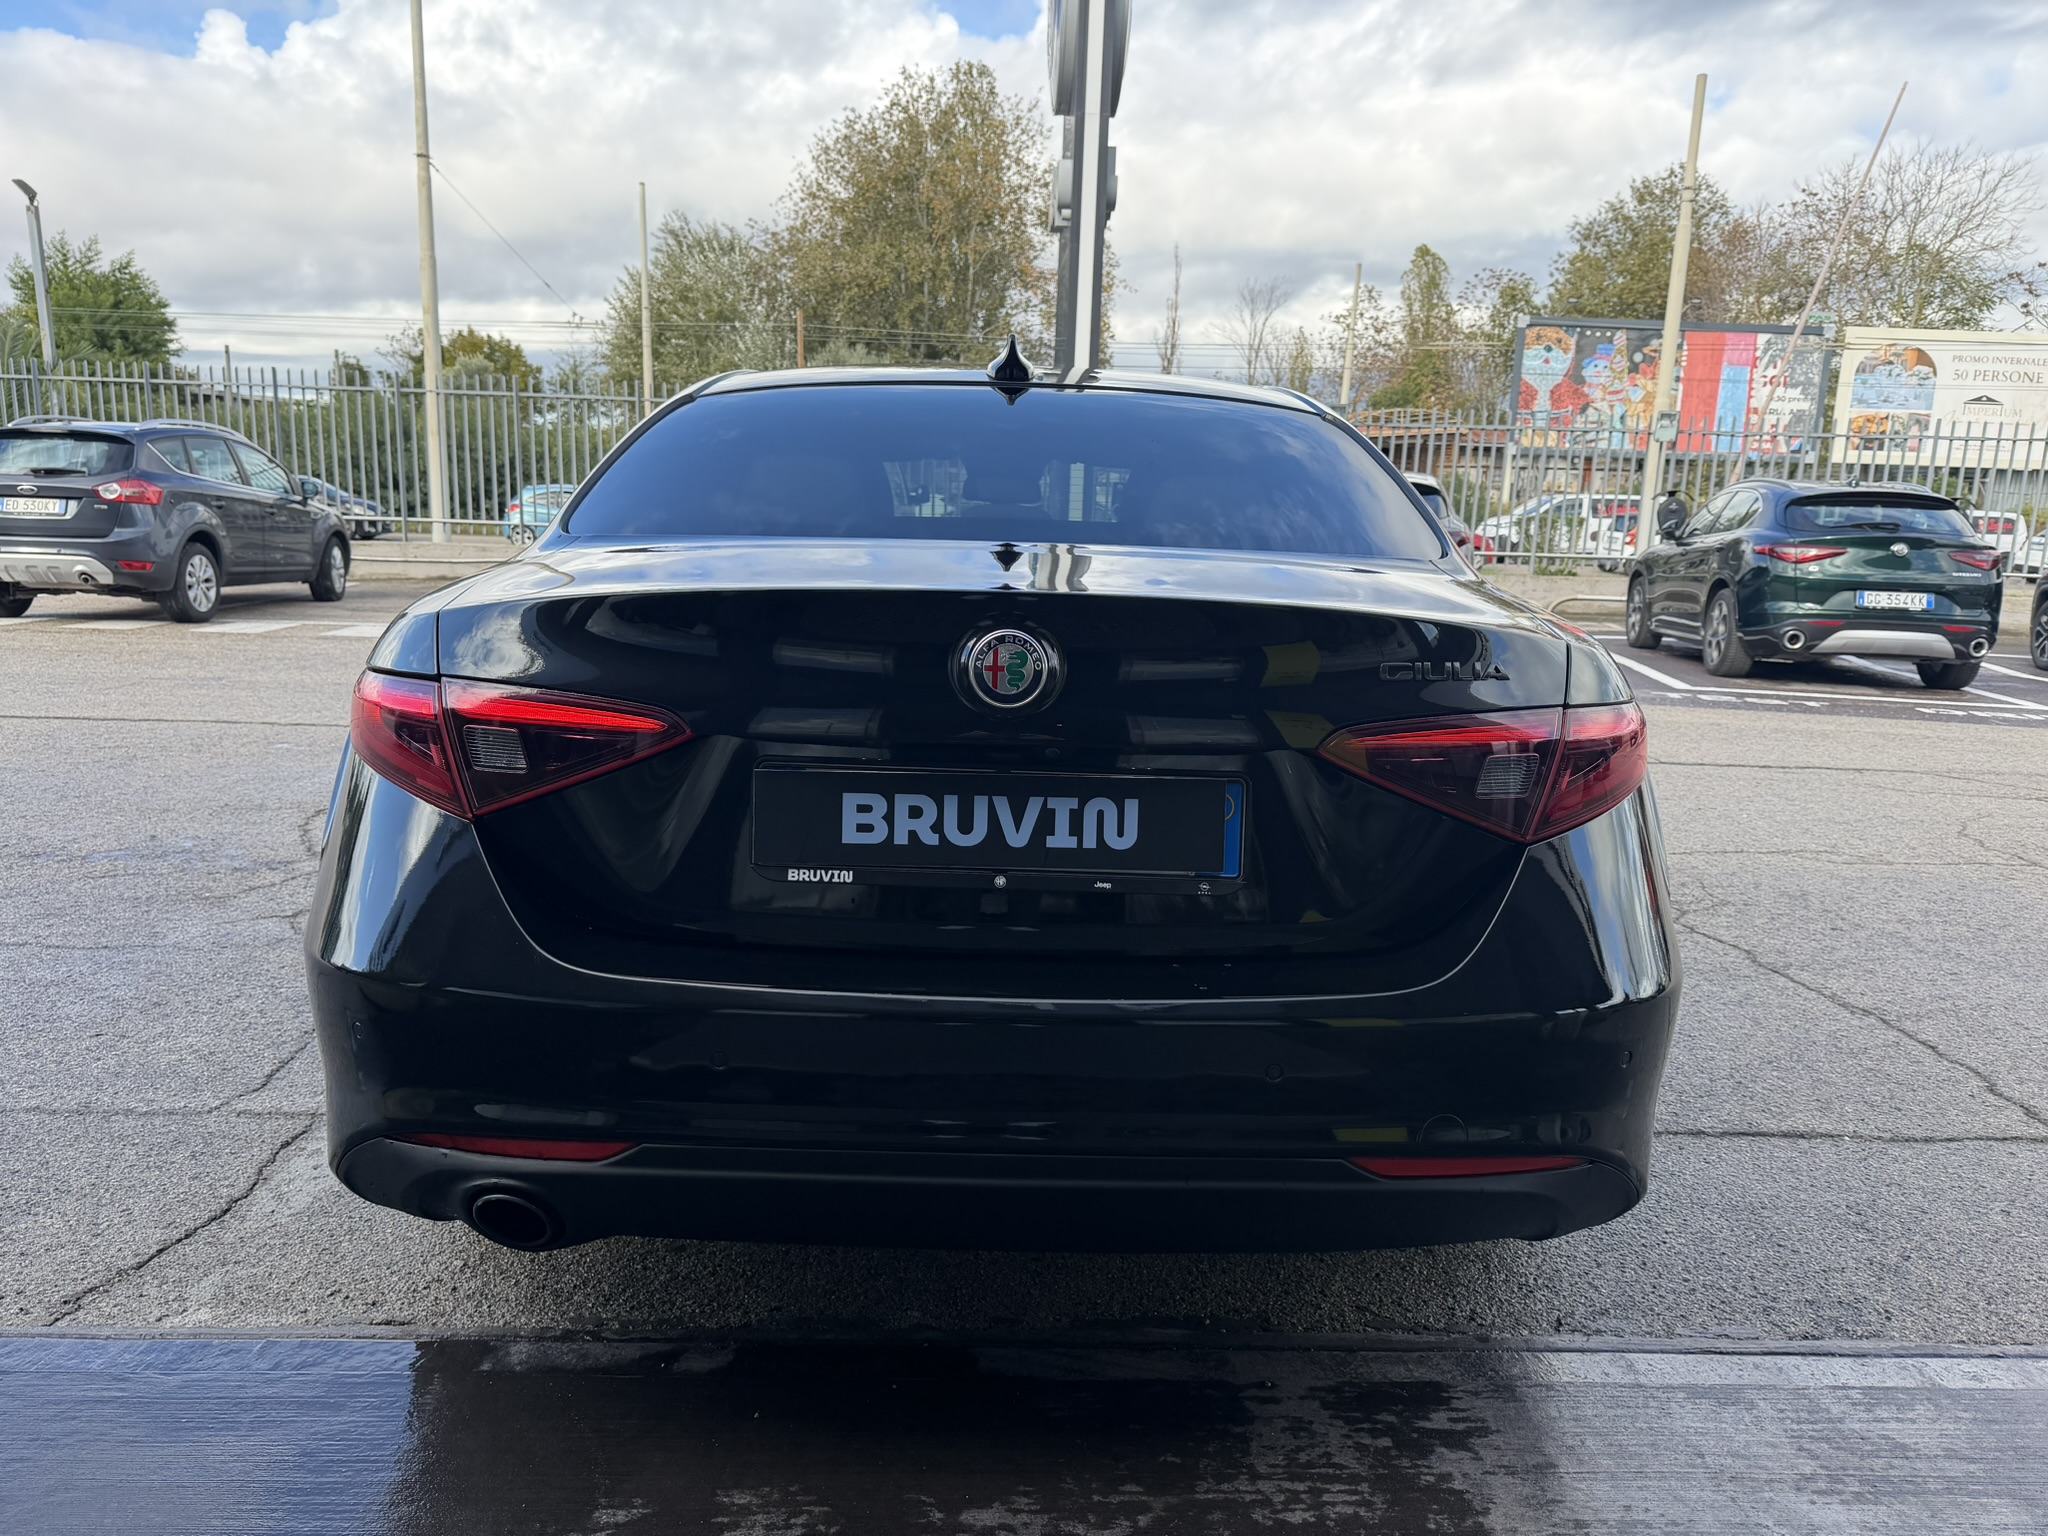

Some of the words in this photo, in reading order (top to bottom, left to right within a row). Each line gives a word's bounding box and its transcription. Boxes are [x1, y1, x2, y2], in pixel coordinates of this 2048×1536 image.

[1952, 354, 1990, 364] PROMO
[1991, 356, 2048, 367] INVERNALE
[1952, 369, 1969, 381] 50
[1973, 369, 2044, 384] PERSONE
[1962, 404, 2023, 418] IMPERIUM
[5, 499, 19, 510] ED
[23, 500, 58, 512] 530KY
[1866, 593, 1881, 605] GG
[1886, 593, 1926, 606] 354KK
[975, 639, 999, 669] ALFA
[1005, 635, 1042, 671] ROMEO
[1379, 661, 1511, 681] GIULIA
[841, 792, 1140, 851] BRUVIN
[787, 868, 854, 883] BRUVIN
[1094, 881, 1112, 889] Jeep
